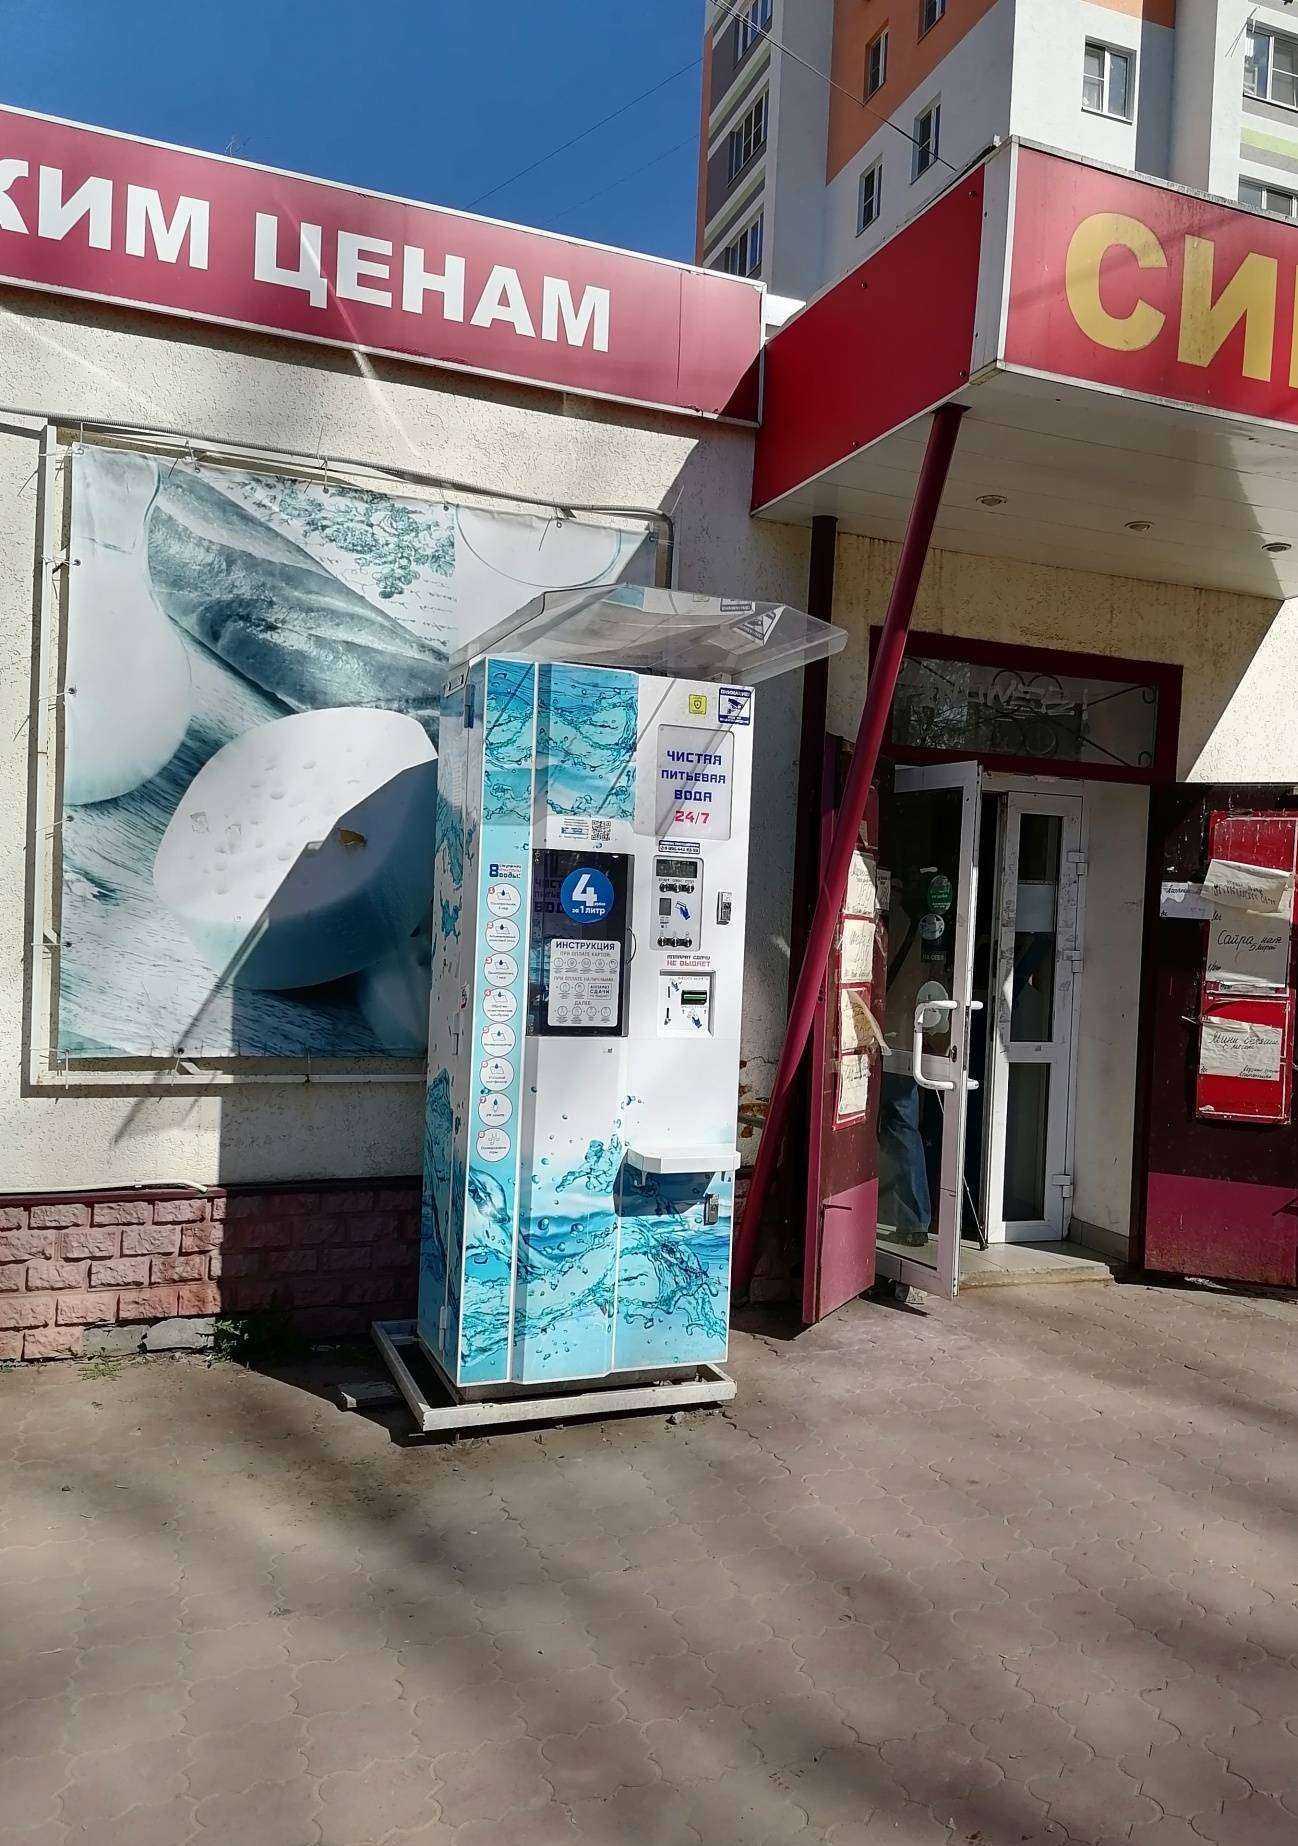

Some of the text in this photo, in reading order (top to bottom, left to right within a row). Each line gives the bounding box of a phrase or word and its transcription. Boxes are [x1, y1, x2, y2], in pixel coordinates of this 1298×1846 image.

[253, 211, 610, 353] ЦЕНАМ
[1066, 211, 1298, 388] СИ
[667, 750, 722, 765] ЧИСТАЯ
[661, 769, 726, 784] ПИТЬЕВАЯ
[674, 789, 713, 802] ВОДА
[674, 810, 710, 824] 24/7
[571, 873, 598, 906] 4
[579, 906, 584, 914] 1
[585, 907, 606, 916] литр
[555, 941, 615, 951] ИНСТРУКЦИЯ
